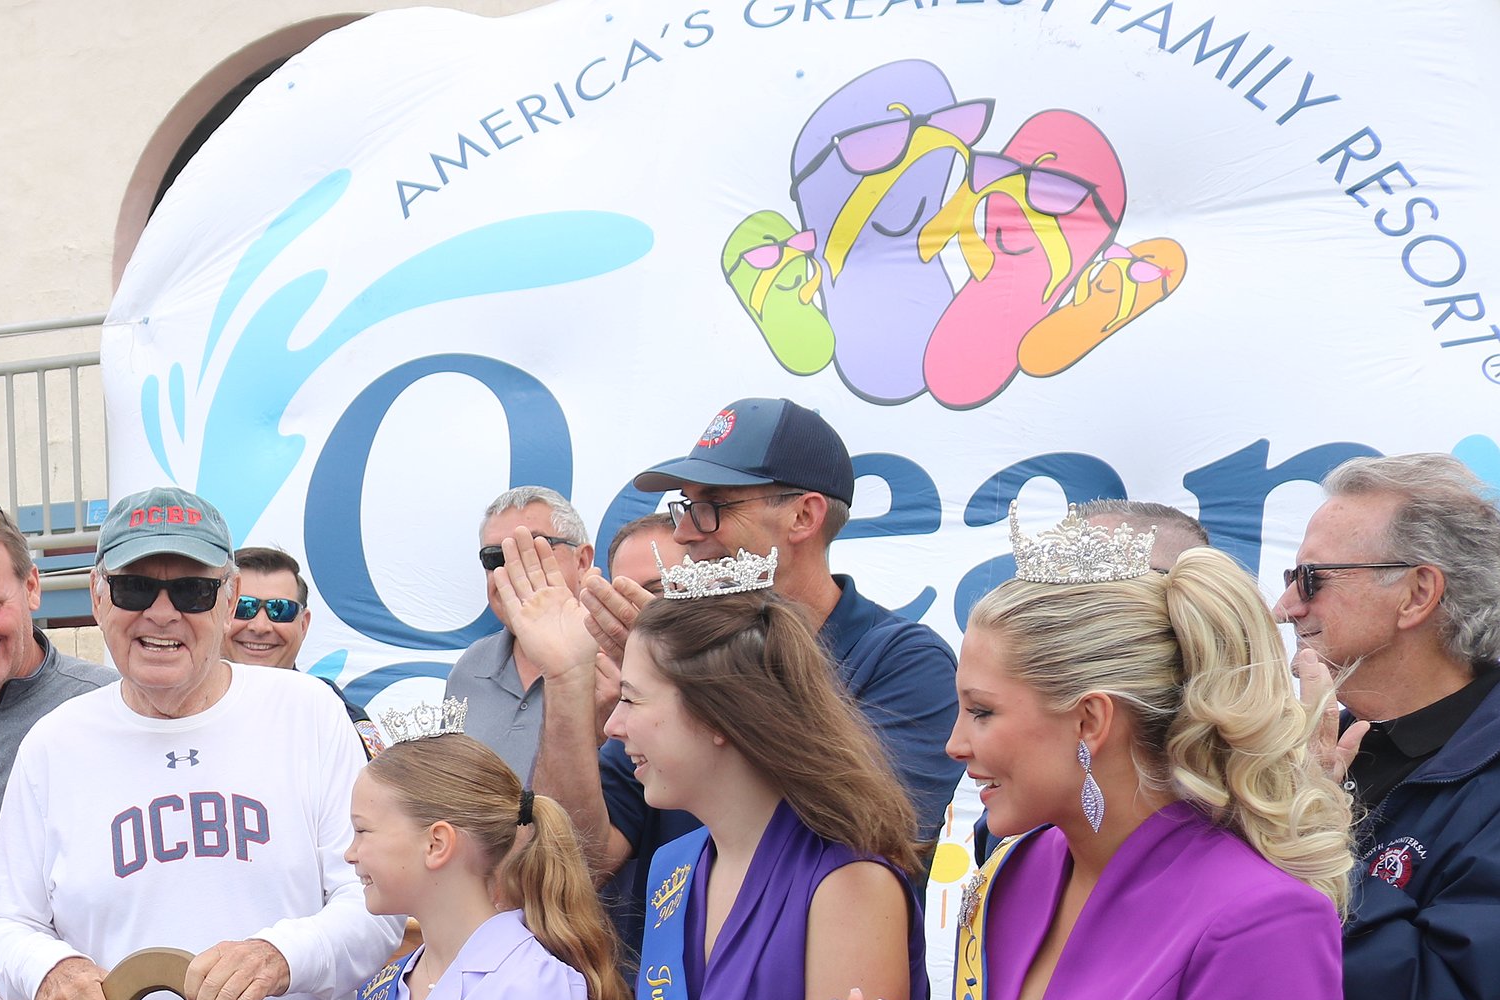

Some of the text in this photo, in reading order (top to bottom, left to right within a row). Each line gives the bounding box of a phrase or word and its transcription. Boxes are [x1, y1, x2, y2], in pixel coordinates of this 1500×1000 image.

[395, 9, 716, 220] AMERICA'S
[128, 505, 202, 528] OCBP
[110, 791, 271, 879] OCBP
